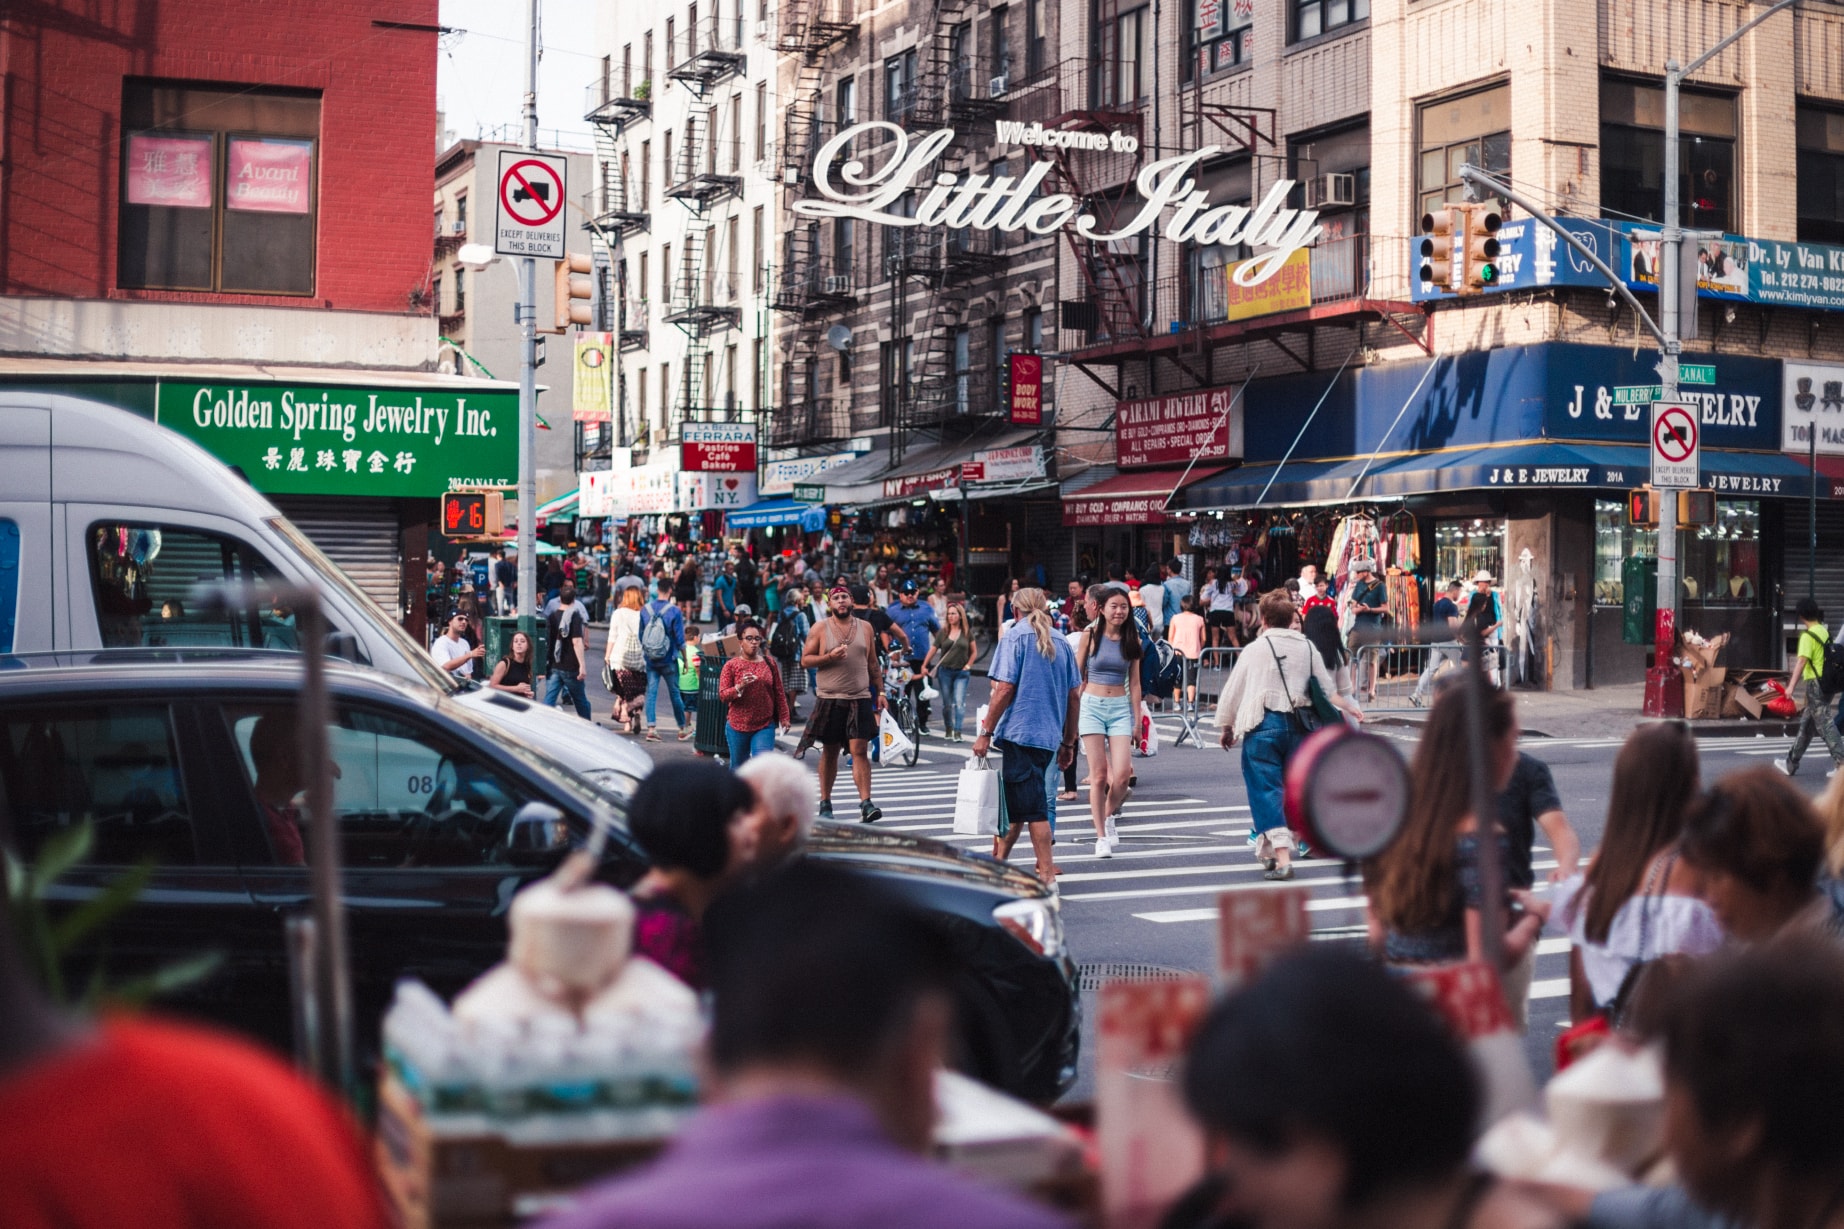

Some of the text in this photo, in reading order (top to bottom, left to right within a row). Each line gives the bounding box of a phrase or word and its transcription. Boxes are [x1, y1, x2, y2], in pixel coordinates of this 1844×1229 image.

[996, 119, 1139, 153] Welcome to
[237, 162, 299, 182] Avani
[790, 120, 1077, 235] Little
[1078, 144, 1323, 288] Italy
[500, 229, 560, 242] EXCEPT DELIVERIES
[508, 241, 552, 252] THIS BLOCK
[1749, 241, 1771, 264] Dr.
[1776, 244, 1791, 269] Ly
[1797, 246, 1824, 270] Van
[1761, 270, 1779, 286] Tel.
[1781, 272, 1798, 288] 212
[1680, 367, 1706, 383] CANAL
[1016, 384, 1037, 396] BODY
[1615, 387, 1661, 403] MULBERRY ST
[1013, 397, 1038, 409] WORK
[1129, 393, 1208, 424] ARAMI JEWELRY
[1569, 385, 1584, 419] J
[1595, 386, 1612, 419] &
[192, 387, 497, 446] Golden Spring Jewelry Inc.
[684, 431, 753, 441] FERRARA
[1131, 440, 1141, 452] ALL
[1144, 437, 1166, 451] REPAIRS
[1170, 434, 1194, 448] SPECIAL
[698, 443, 739, 453] Pastries
[707, 452, 731, 461] Café
[701, 460, 737, 471] Bakery
[1656, 466, 1696, 475] EXCEPT DELIVERIES
[886, 478, 903, 497] NY
[926, 469, 953, 482] SHOP
[1490, 468, 1590, 483] J & E JEWELRY
[1606, 471, 1624, 483] 201A
[1661, 475, 1690, 484] THIS BLOCK
[1708, 475, 1782, 493] JEWELRY
[470, 502, 483, 529] 16
[1075, 502, 1087, 514] BUY
[1089, 502, 1104, 513] GOLD
[408, 775, 433, 794] 08
